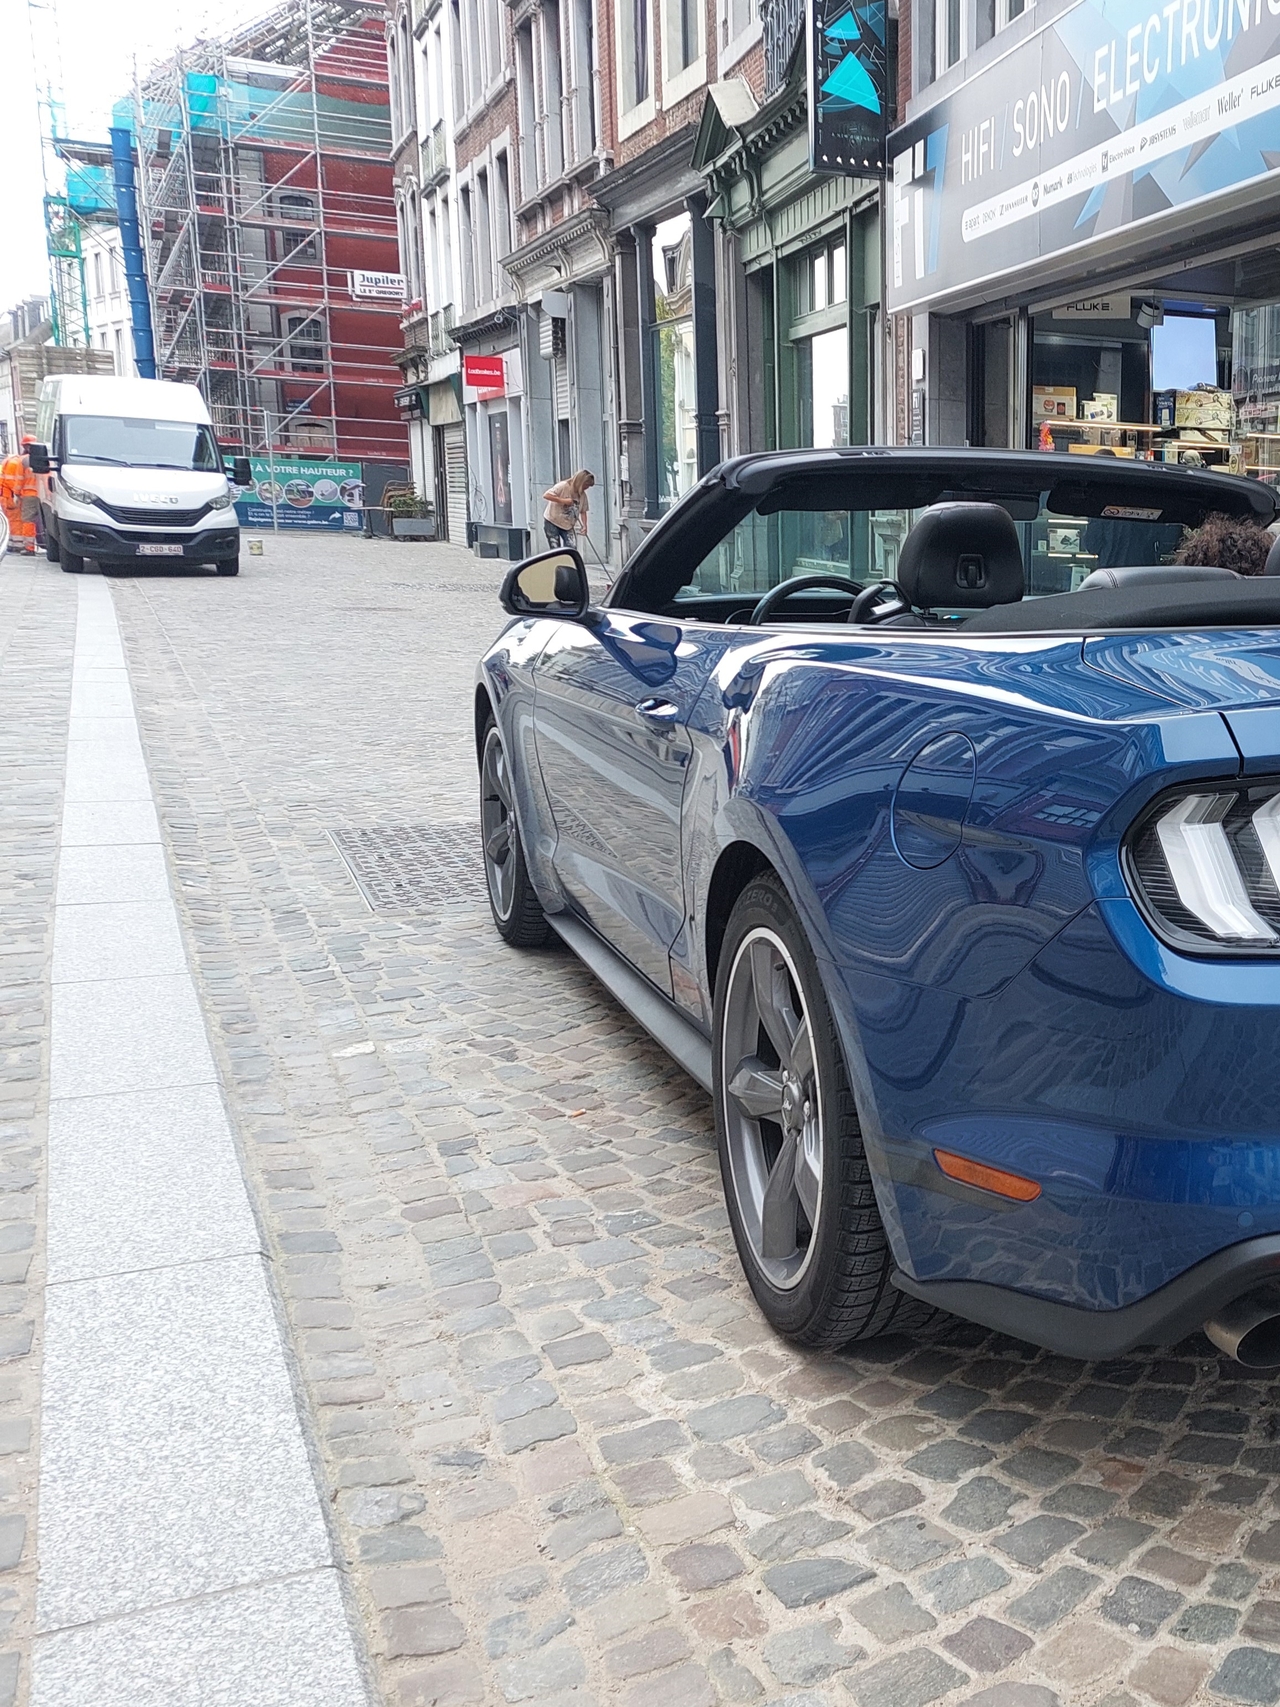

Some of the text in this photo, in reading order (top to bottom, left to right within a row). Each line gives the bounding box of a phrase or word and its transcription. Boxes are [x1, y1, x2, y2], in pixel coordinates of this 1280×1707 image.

[1217, 89, 1242, 117] Weller
[961, 116, 995, 186] HIFI
[1013, 70, 1071, 157] SONO
[1043, 176, 1064, 197] Numark
[359, 273, 404, 287] Jupiler
[467, 367, 502, 377] Ladbrokes.be
[1252, 373, 1278, 385] Pioneer
[255, 461, 264, 473] À
[265, 464, 299, 475] VOTRE
[300, 466, 347, 477] HAUTEUR
[348, 469, 354, 477] ?
[133, 492, 179, 504] IVECO
